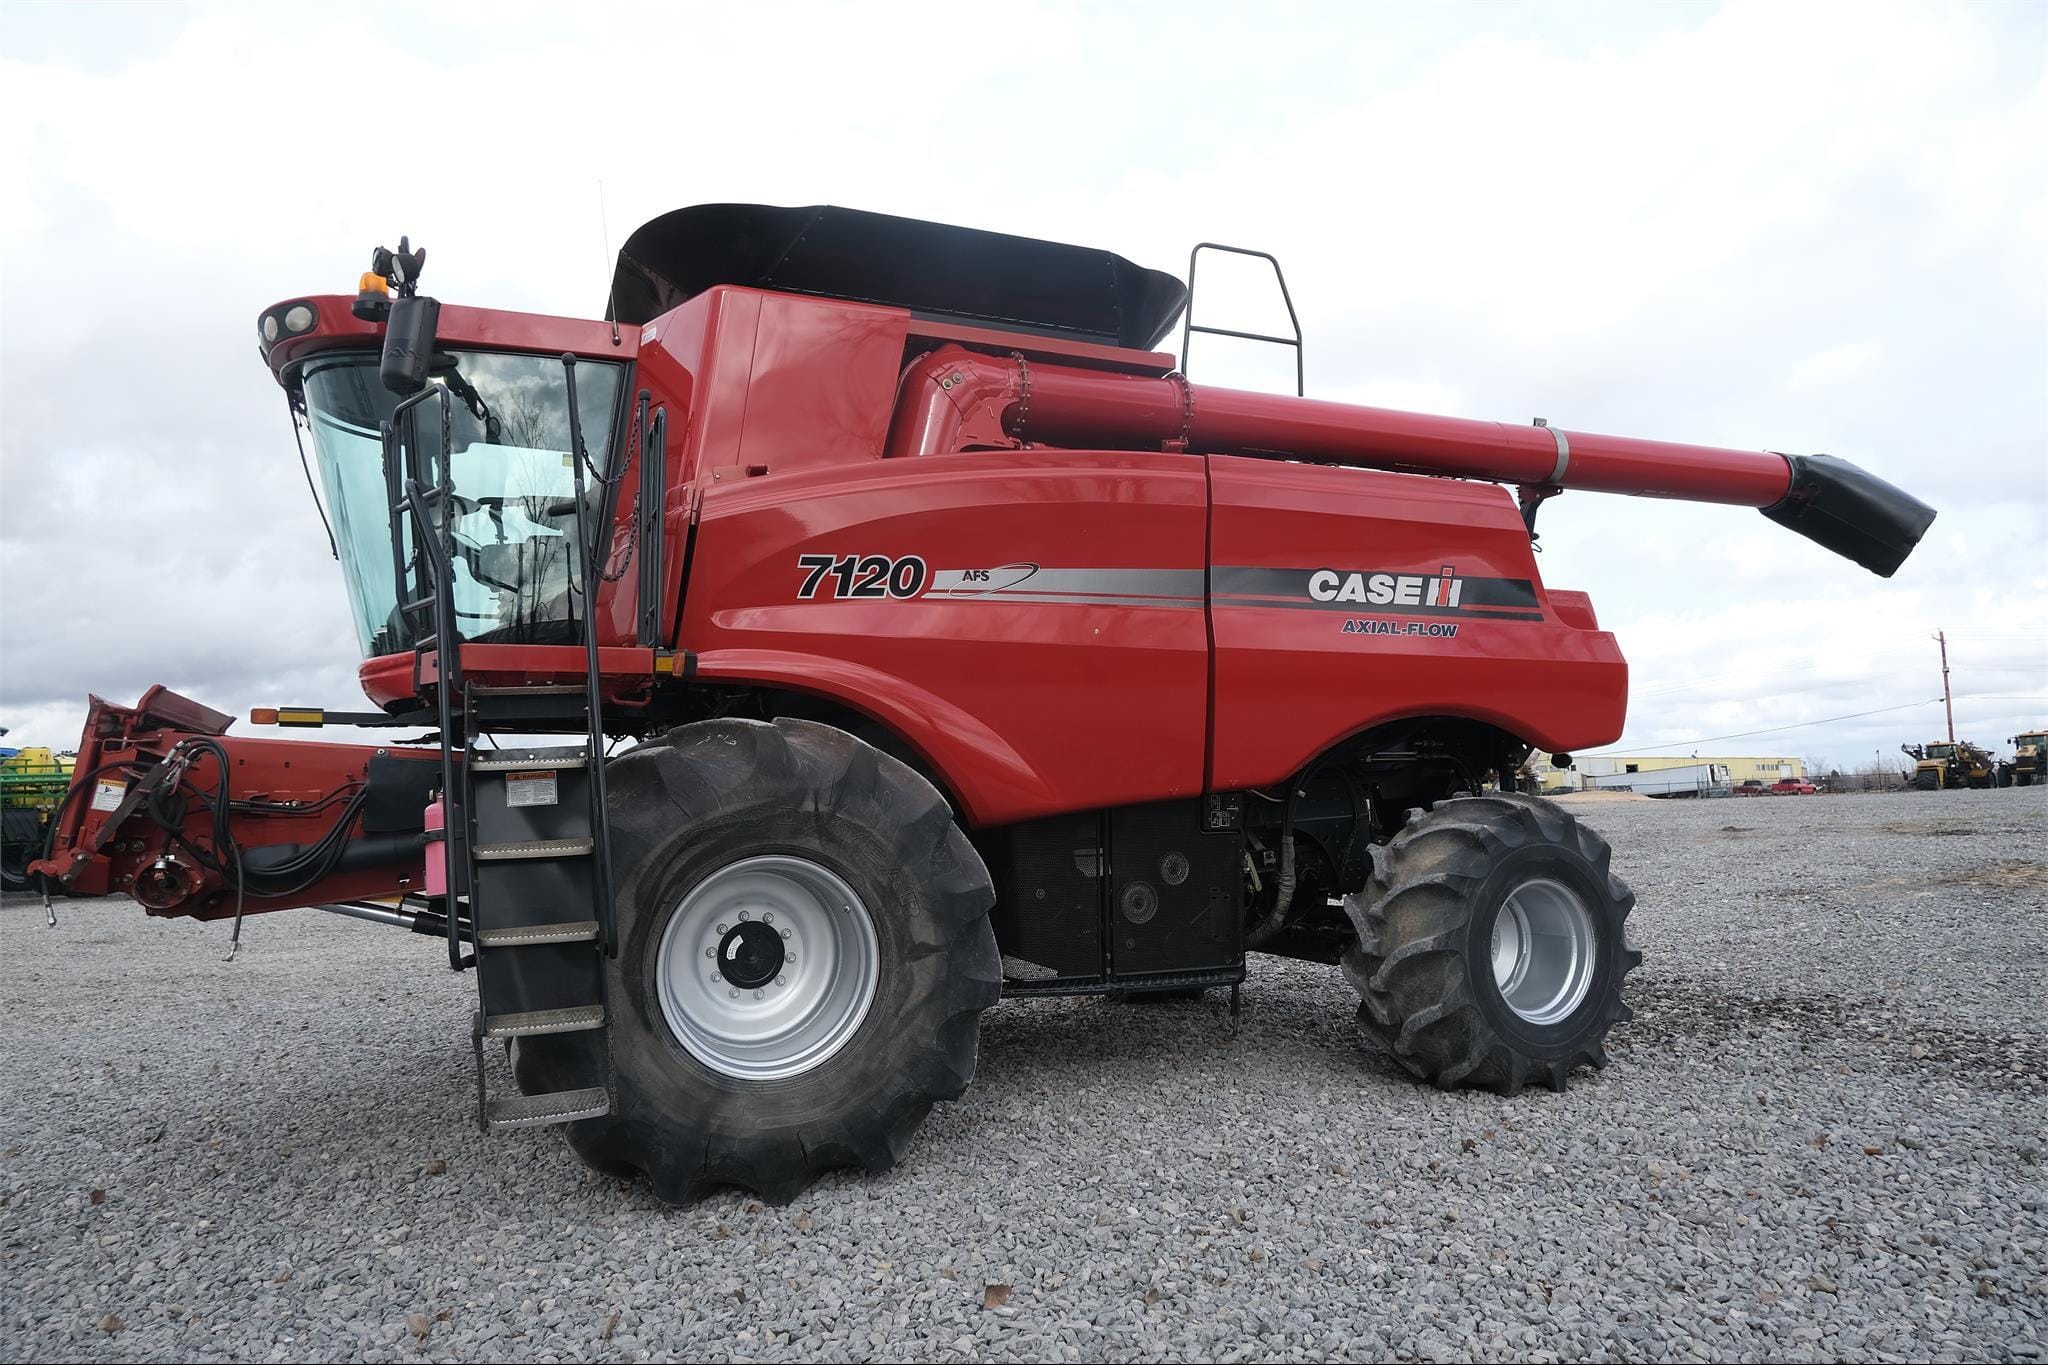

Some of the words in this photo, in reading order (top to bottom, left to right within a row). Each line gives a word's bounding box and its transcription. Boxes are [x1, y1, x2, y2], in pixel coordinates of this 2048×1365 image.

[797, 554, 926, 599] 7120
[961, 570, 990, 582] AFS
[1341, 619, 1459, 638] AXIAL-FLOW
